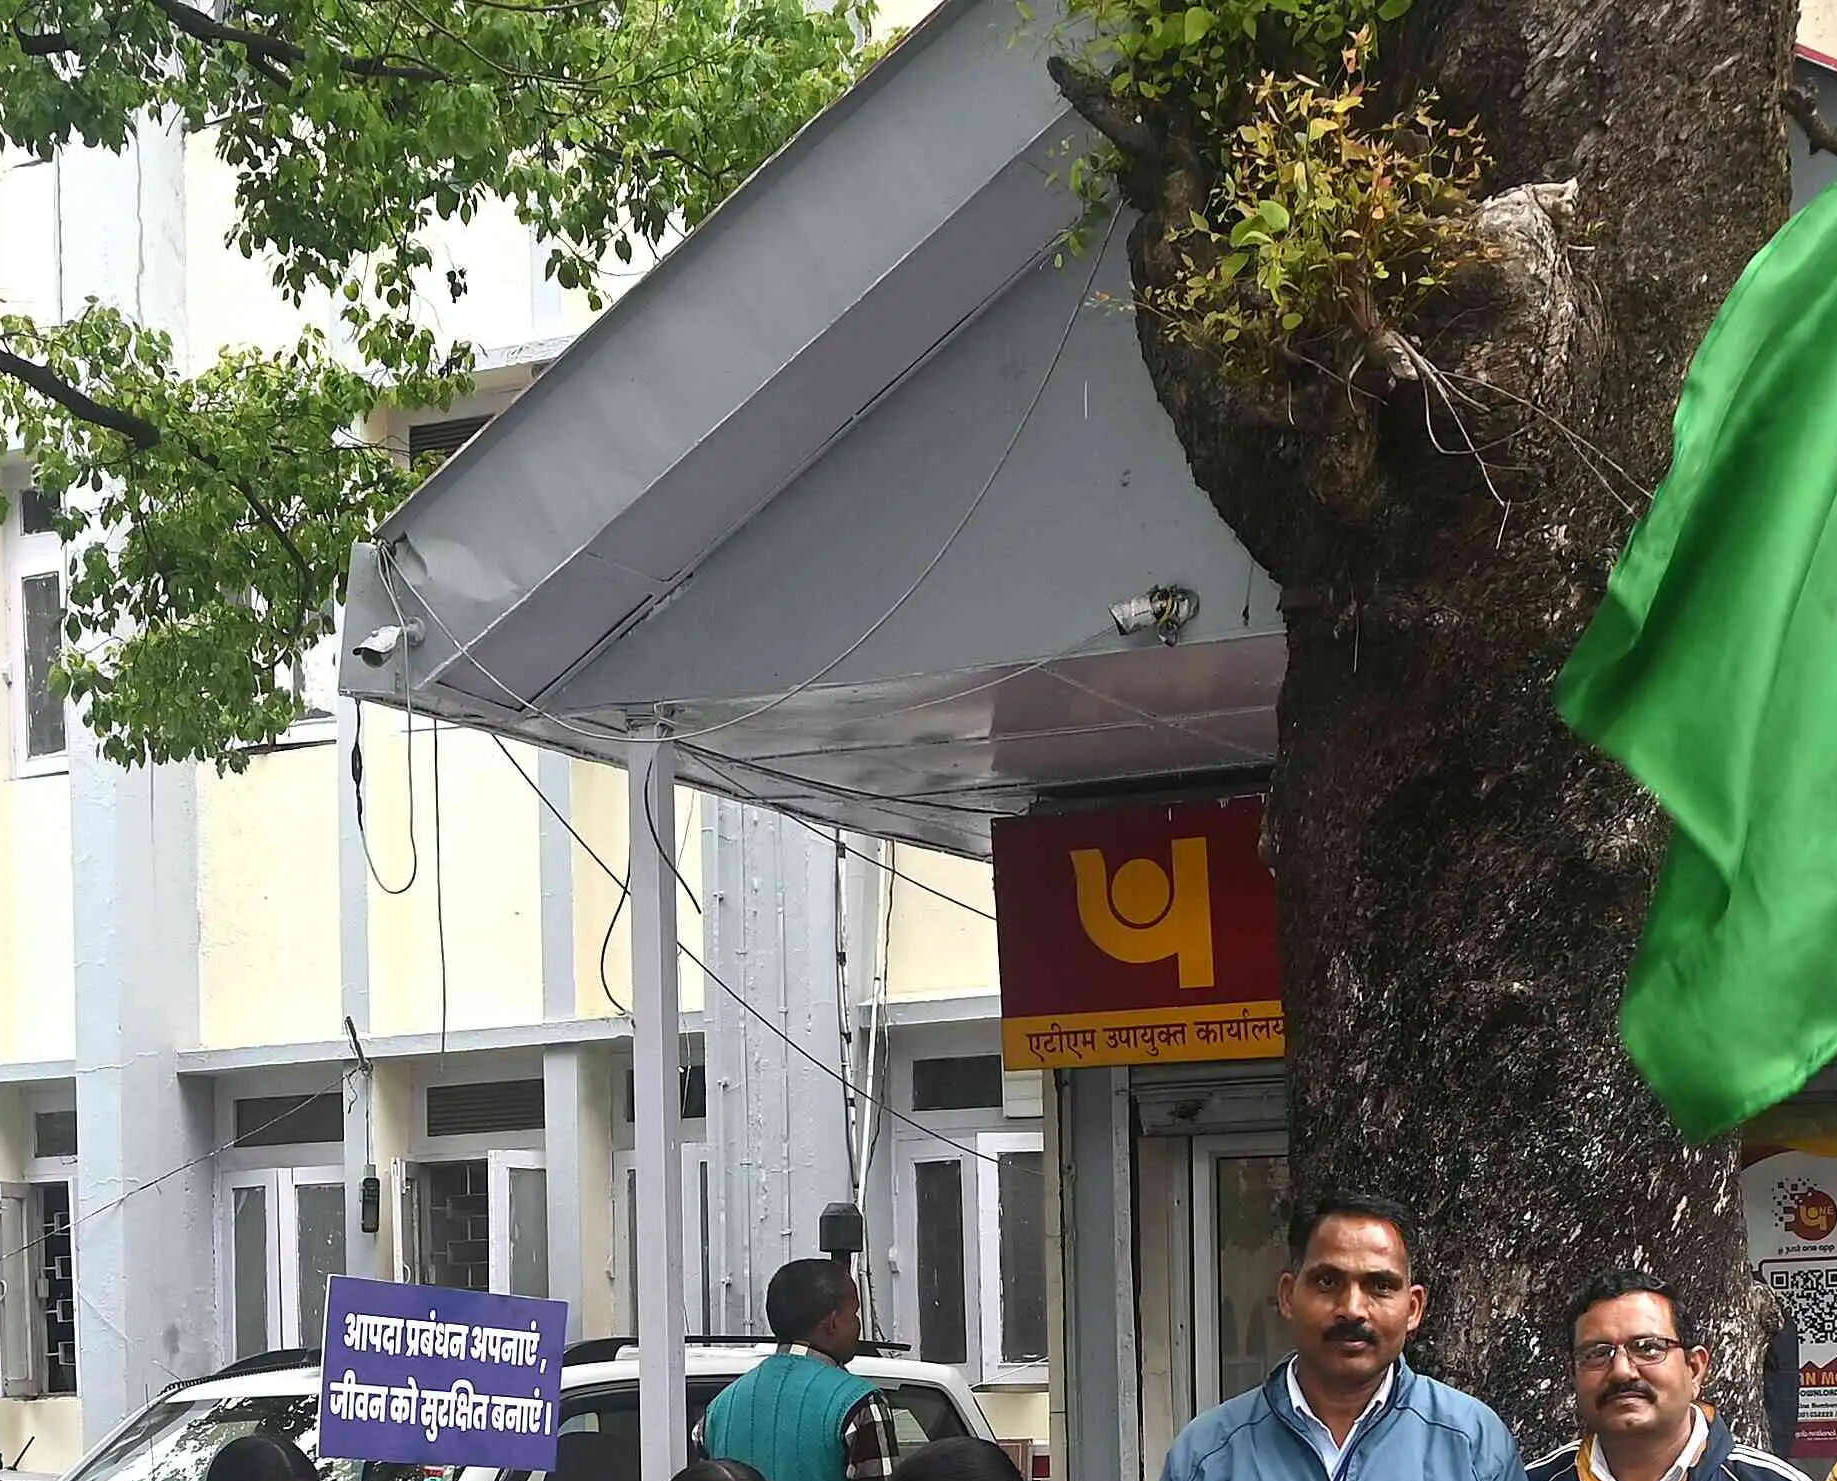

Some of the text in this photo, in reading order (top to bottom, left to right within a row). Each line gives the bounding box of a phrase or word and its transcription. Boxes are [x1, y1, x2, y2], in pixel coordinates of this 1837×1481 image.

[1026, 1008, 1286, 1062] एटीएम उपायुक्त कार्यालय
[343, 1312, 405, 1356] आपदा
[405, 1309, 469, 1361] प्रबंधन
[329, 1369, 388, 1423] जीवन
[389, 1376, 419, 1425] को
[419, 1378, 491, 1442] सुरक्षित
